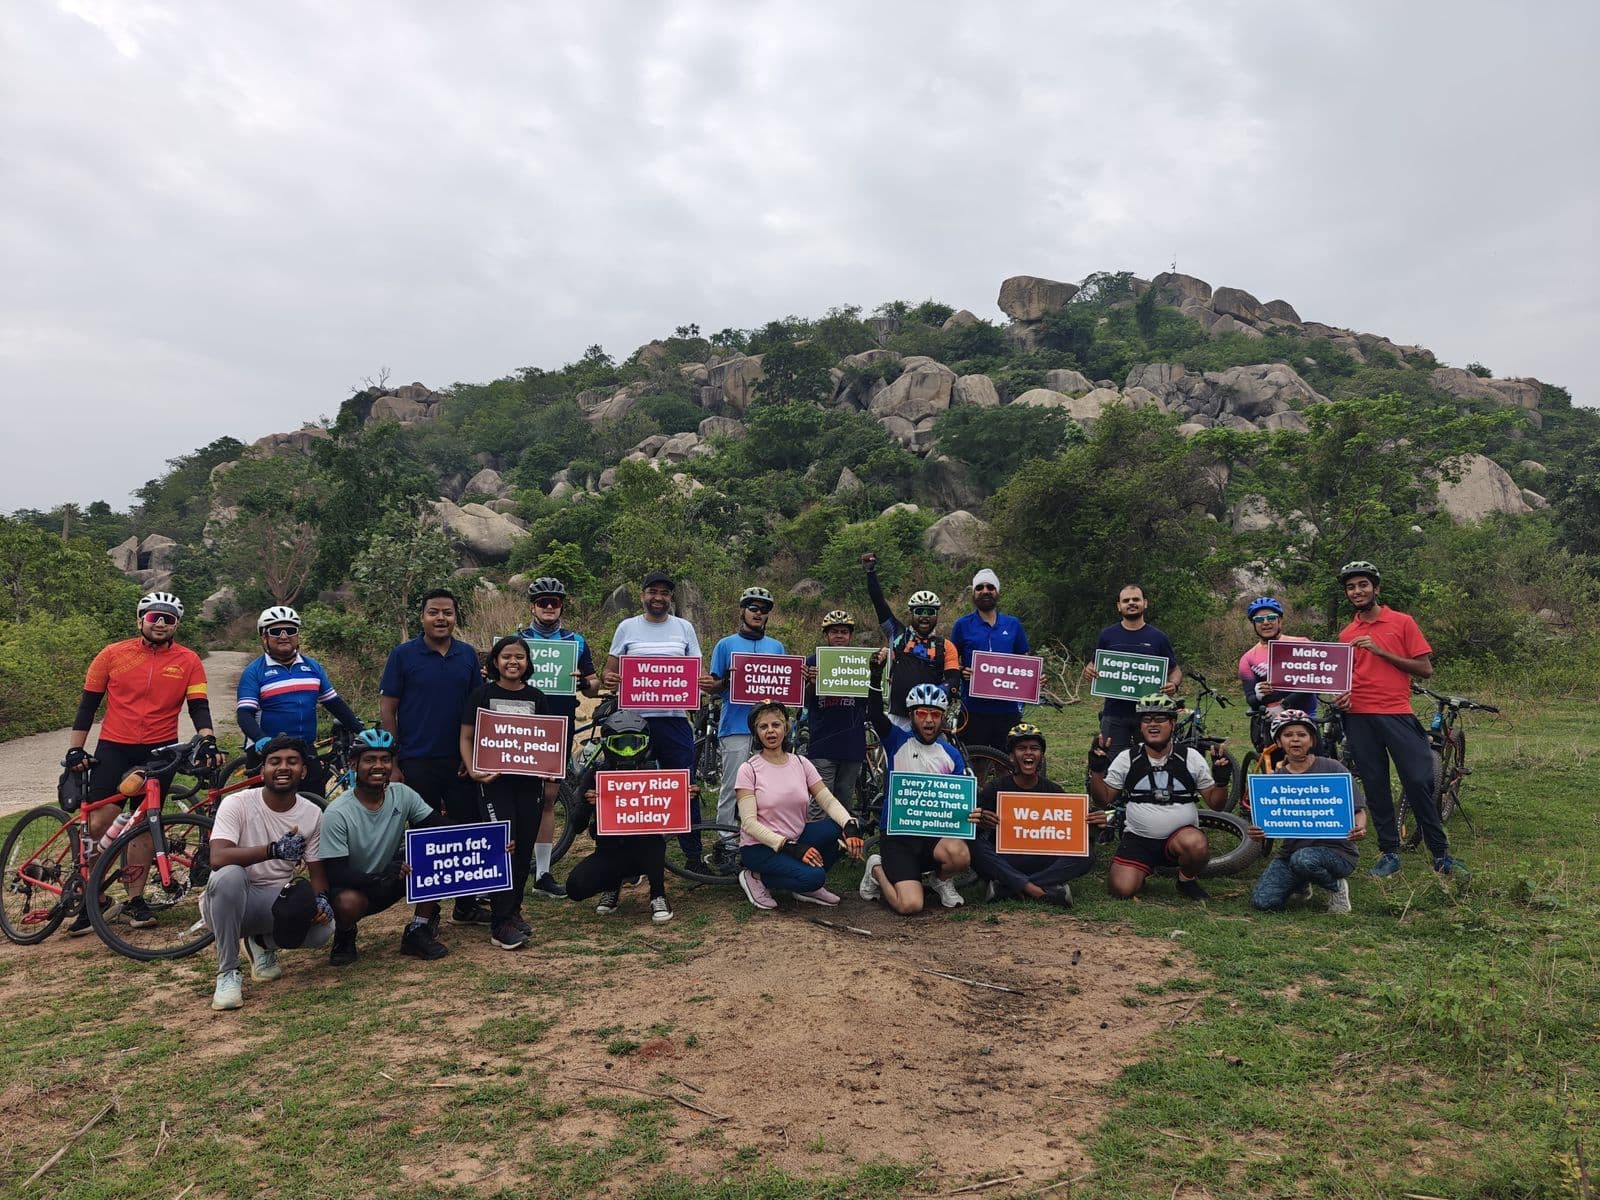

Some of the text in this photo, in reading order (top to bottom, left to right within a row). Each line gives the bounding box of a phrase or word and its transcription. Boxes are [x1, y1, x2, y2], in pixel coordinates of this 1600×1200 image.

[531, 647, 561, 658] ycle
[1292, 648, 1328, 658] Make
[839, 655, 867, 664] Think
[1103, 658, 1159, 672] Keep calm
[534, 662, 562, 676] ndly
[638, 663, 684, 673] Wanna
[745, 664, 792, 674] CYCLING
[980, 663, 1034, 677] One Less
[1281, 661, 1338, 671] roads for
[831, 667, 871, 677] globally
[1098, 670, 1161, 684] and bicycle
[528, 677, 558, 688] nchi
[633, 676, 688, 687] bike ride
[745, 674, 791, 685] CLIMATE
[822, 678, 849, 688] cycle
[993, 678, 1019, 689] Car.
[1284, 673, 1333, 685] cyclists
[745, 685, 789, 695] JUSTICE
[1121, 685, 1135, 693] on
[631, 691, 689, 702] with me?
[494, 724, 545, 737] When in
[481, 737, 559, 753] doubt, pedal
[501, 752, 538, 764] it out.
[608, 778, 679, 793] Every Ride
[902, 779, 926, 789] Every
[933, 781, 948, 789] KM
[904, 788, 936, 799] Bicycle
[938, 791, 965, 800] Saves
[1271, 785, 1330, 796] A bicycle is
[616, 794, 671, 809] is a Tiny
[909, 798, 920, 806] of
[920, 799, 939, 808] CO2
[940, 801, 961, 809] That
[1260, 796, 1343, 805] the finest mode
[907, 808, 923, 816] Car
[1013, 808, 1073, 821] We ARE
[1270, 808, 1334, 818] of transport
[617, 811, 670, 825] Holiday
[899, 818, 960, 829] have polluted
[1264, 819, 1300, 827] known
[1302, 820, 1313, 828] to
[1013, 826, 1071, 840] Traffic!
[426, 837, 491, 855] Burn fat,
[433, 852, 485, 870] not oil.
[417, 865, 502, 888] Let's Pedal.
